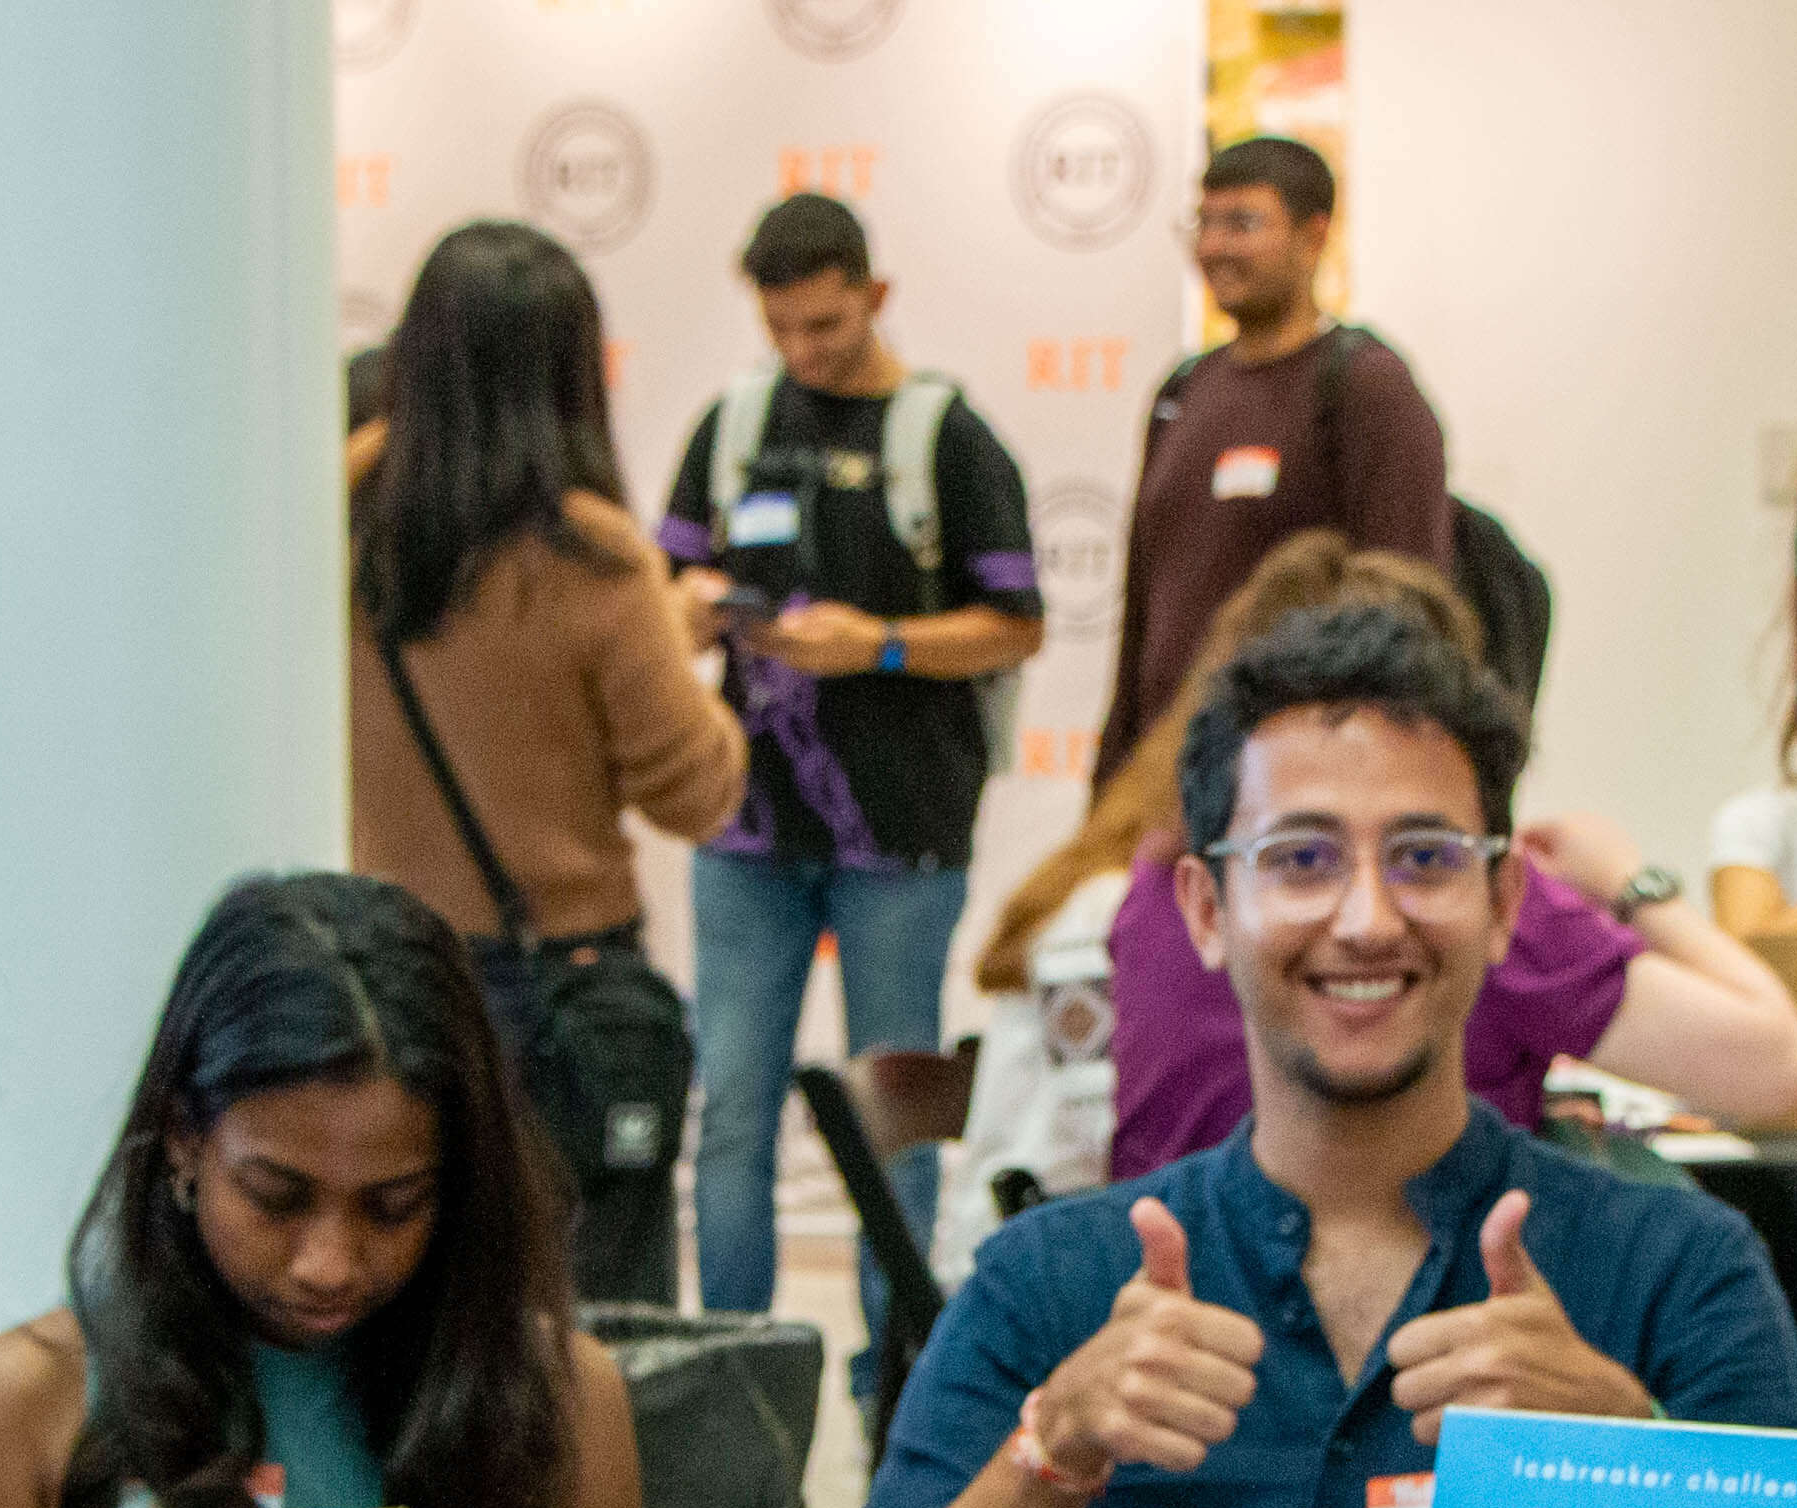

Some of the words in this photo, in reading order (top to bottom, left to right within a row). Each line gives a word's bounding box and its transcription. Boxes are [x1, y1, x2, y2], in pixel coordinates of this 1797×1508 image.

[778, 146, 880, 200] RIT
[1026, 336, 1128, 393] RIT
[1022, 728, 1102, 779] RI
